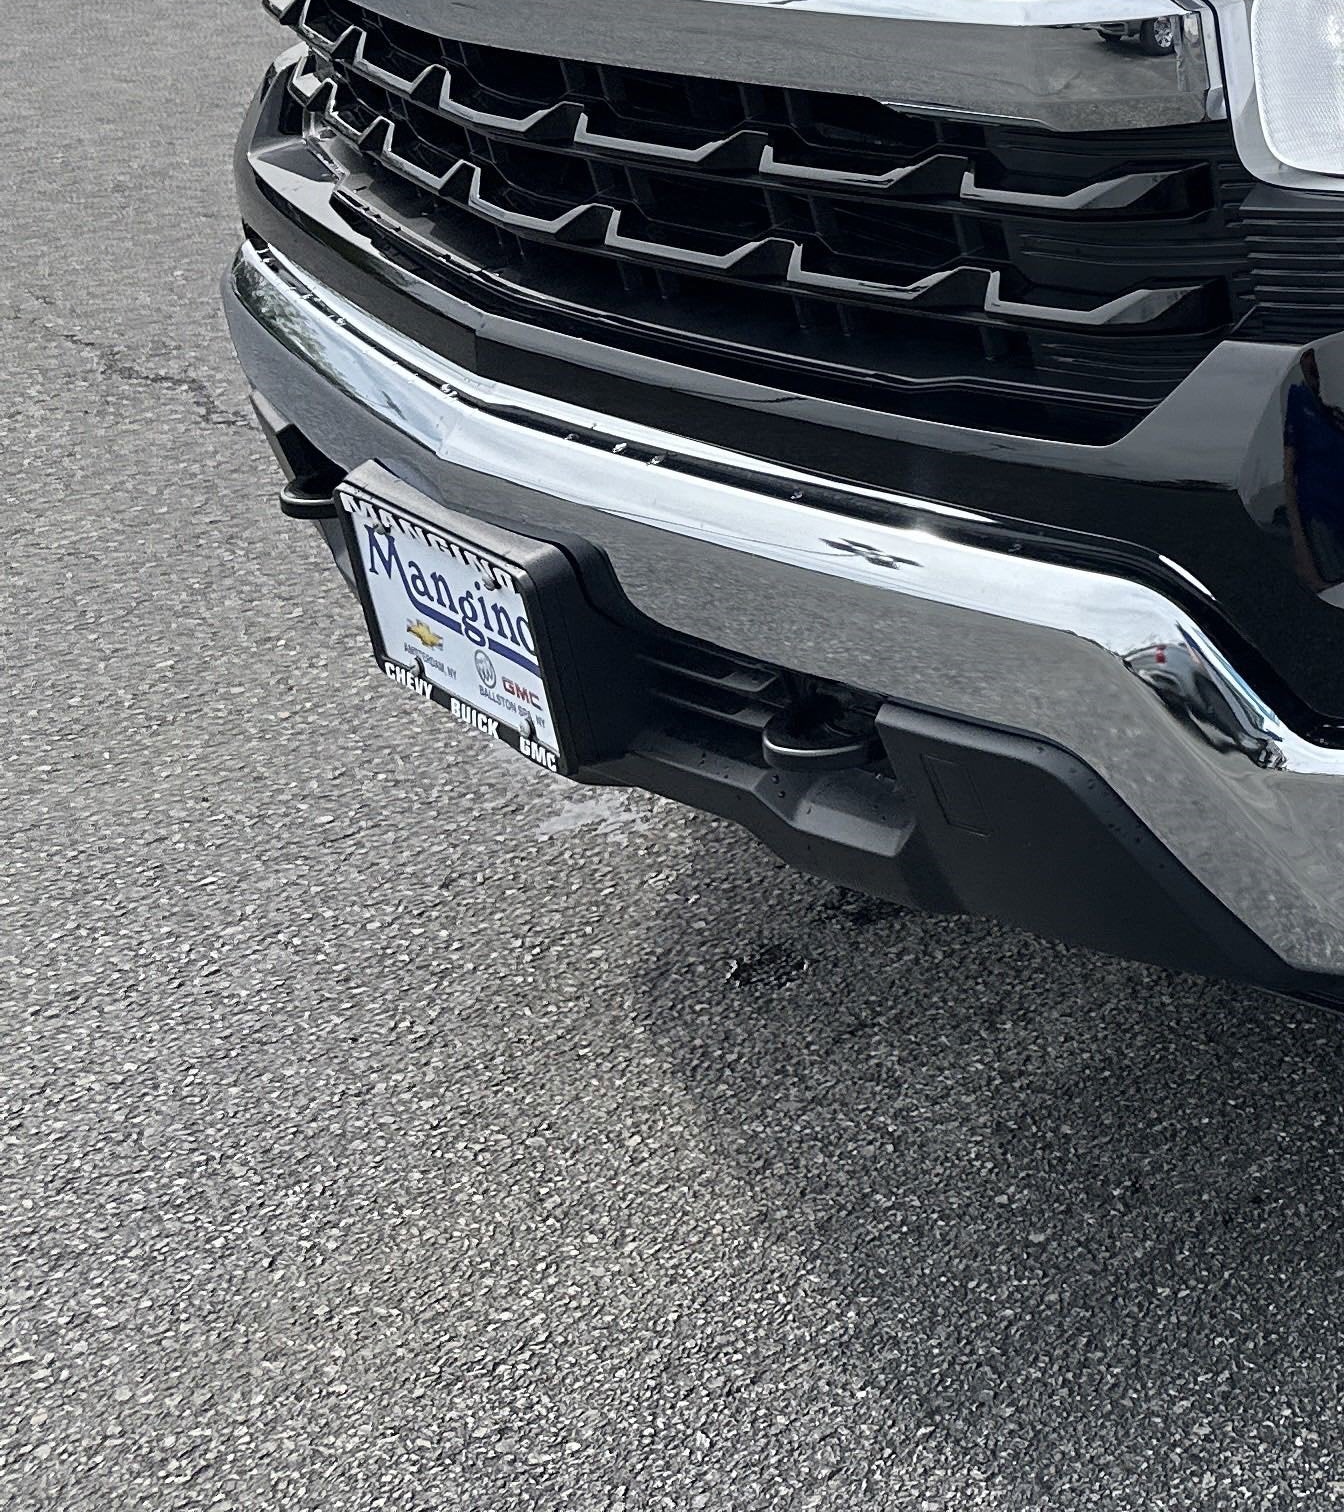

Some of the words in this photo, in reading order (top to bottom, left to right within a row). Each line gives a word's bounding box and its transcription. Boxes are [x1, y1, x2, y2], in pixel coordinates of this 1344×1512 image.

[364, 524, 539, 658] Mangino
[384, 662, 433, 700] CHEVY
[450, 697, 500, 740] BUICK
[519, 736, 557, 772] GMC
[479, 685, 517, 713] BALLSTON
[502, 676, 543, 712] GMC
